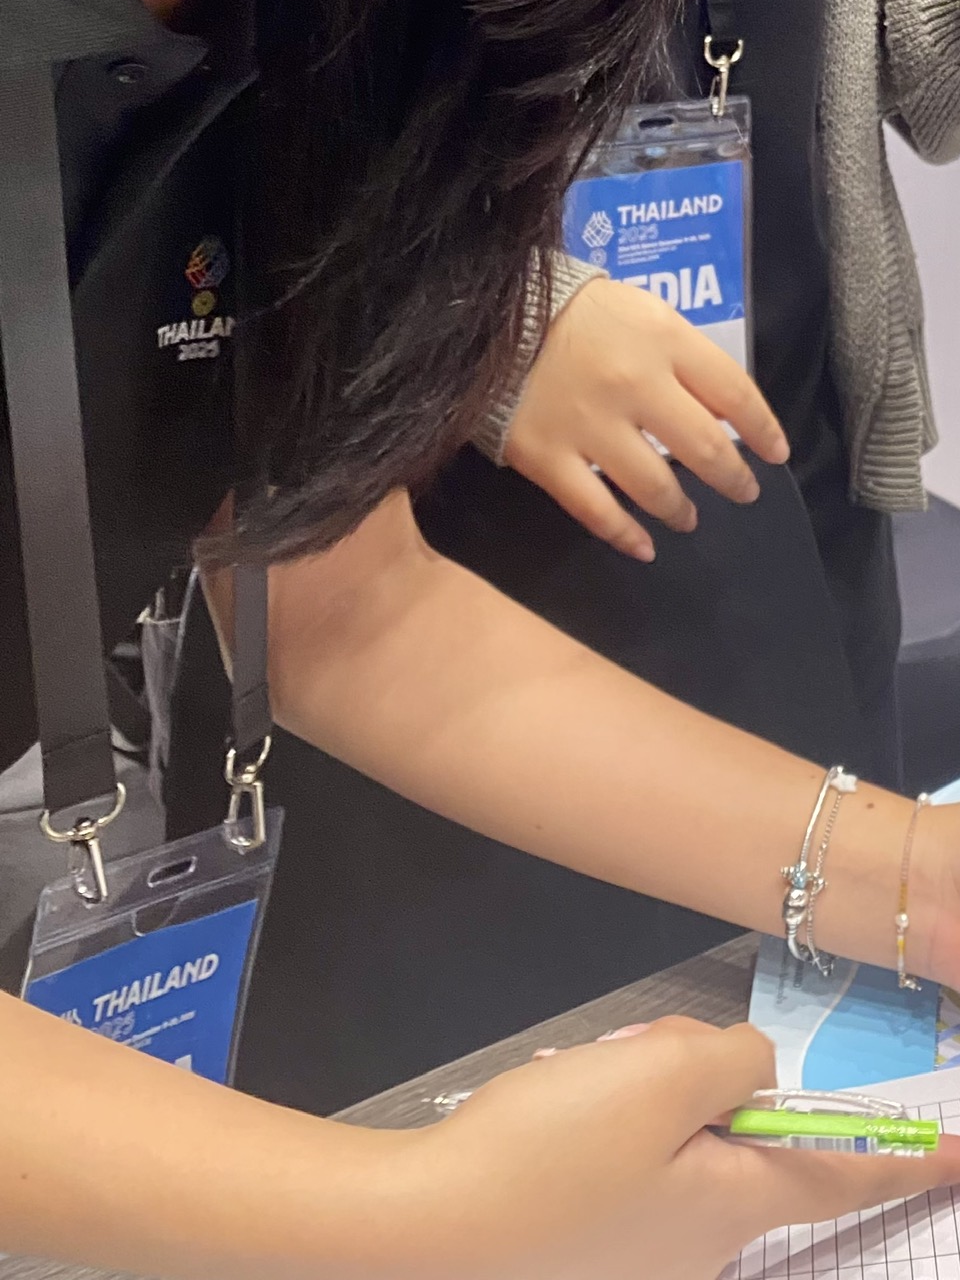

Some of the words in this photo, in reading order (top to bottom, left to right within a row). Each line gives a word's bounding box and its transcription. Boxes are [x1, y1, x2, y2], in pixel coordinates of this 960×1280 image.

[617, 193, 724, 226] THAILAND
[608, 264, 723, 312] DIA
[92, 953, 220, 1023] THAILAND
